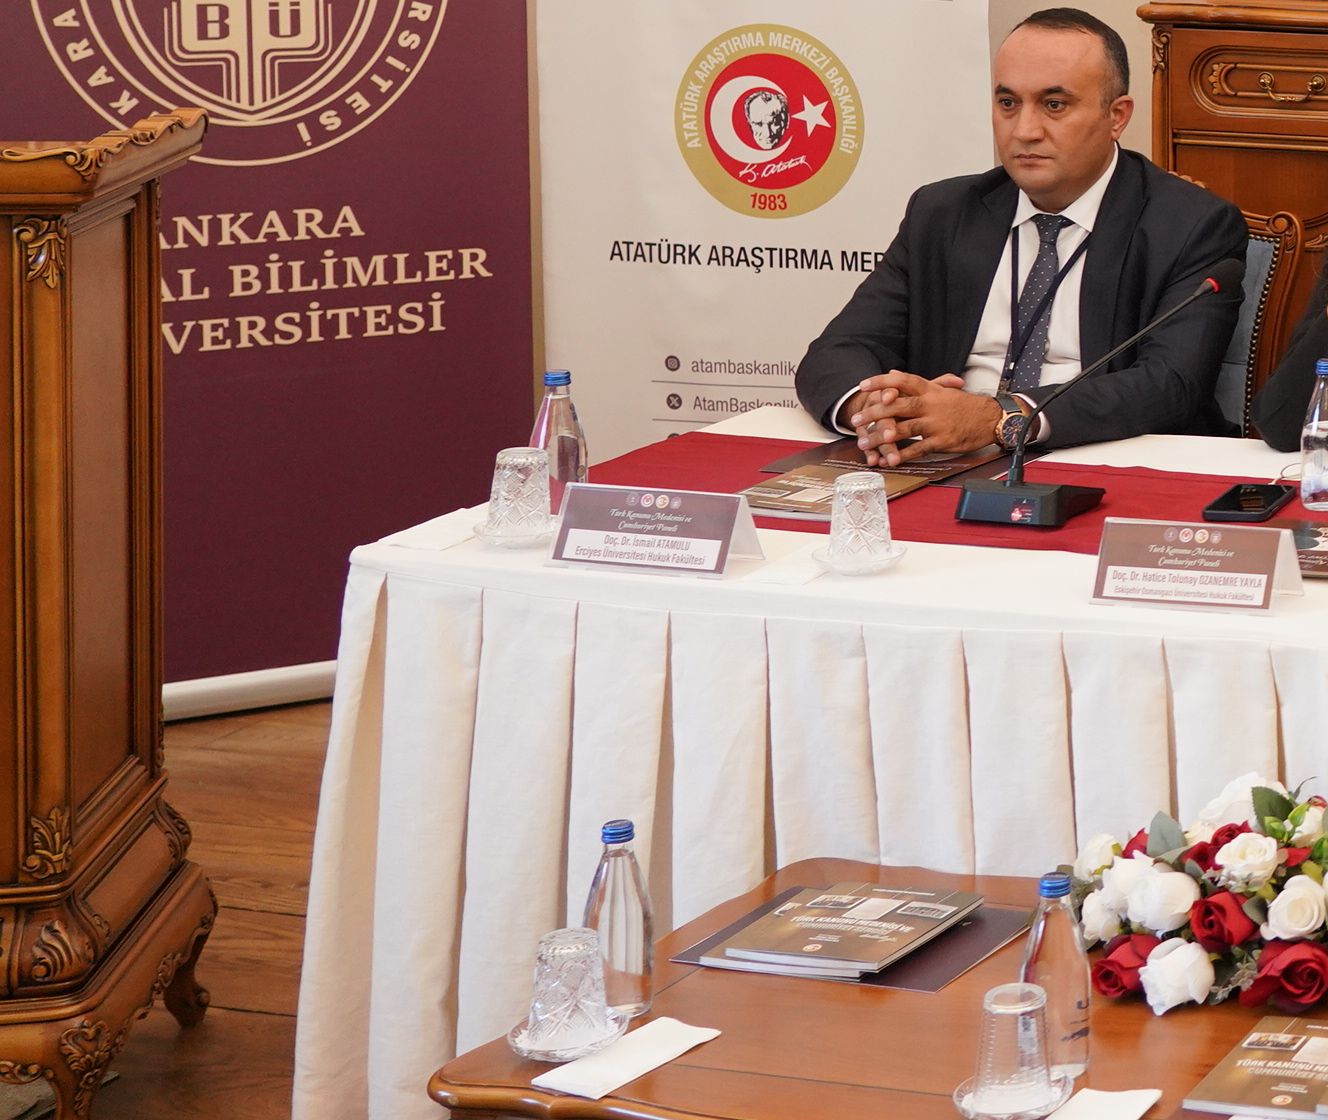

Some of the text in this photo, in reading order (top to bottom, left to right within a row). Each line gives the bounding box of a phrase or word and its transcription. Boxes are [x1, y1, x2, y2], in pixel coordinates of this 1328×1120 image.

[51, 8, 139, 116] KARA
[676, 32, 858, 154] ATATÜRK ARAŞTIRMA MERKEZİ BAŞKANLIĞI
[750, 192, 787, 212] 1983
[228, 247, 492, 298] BİLİMLER
[610, 238, 702, 266] ATATÜRK
[707, 246, 833, 274] ARAŞTIRMA
[162, 291, 446, 355] VERSİTESİ
[575, 546, 705, 565] Erciyes Üniversitesi Hukuk Fakültesi
[604, 535, 690, 550] Doç. Dr. İsmail ATAMULU
